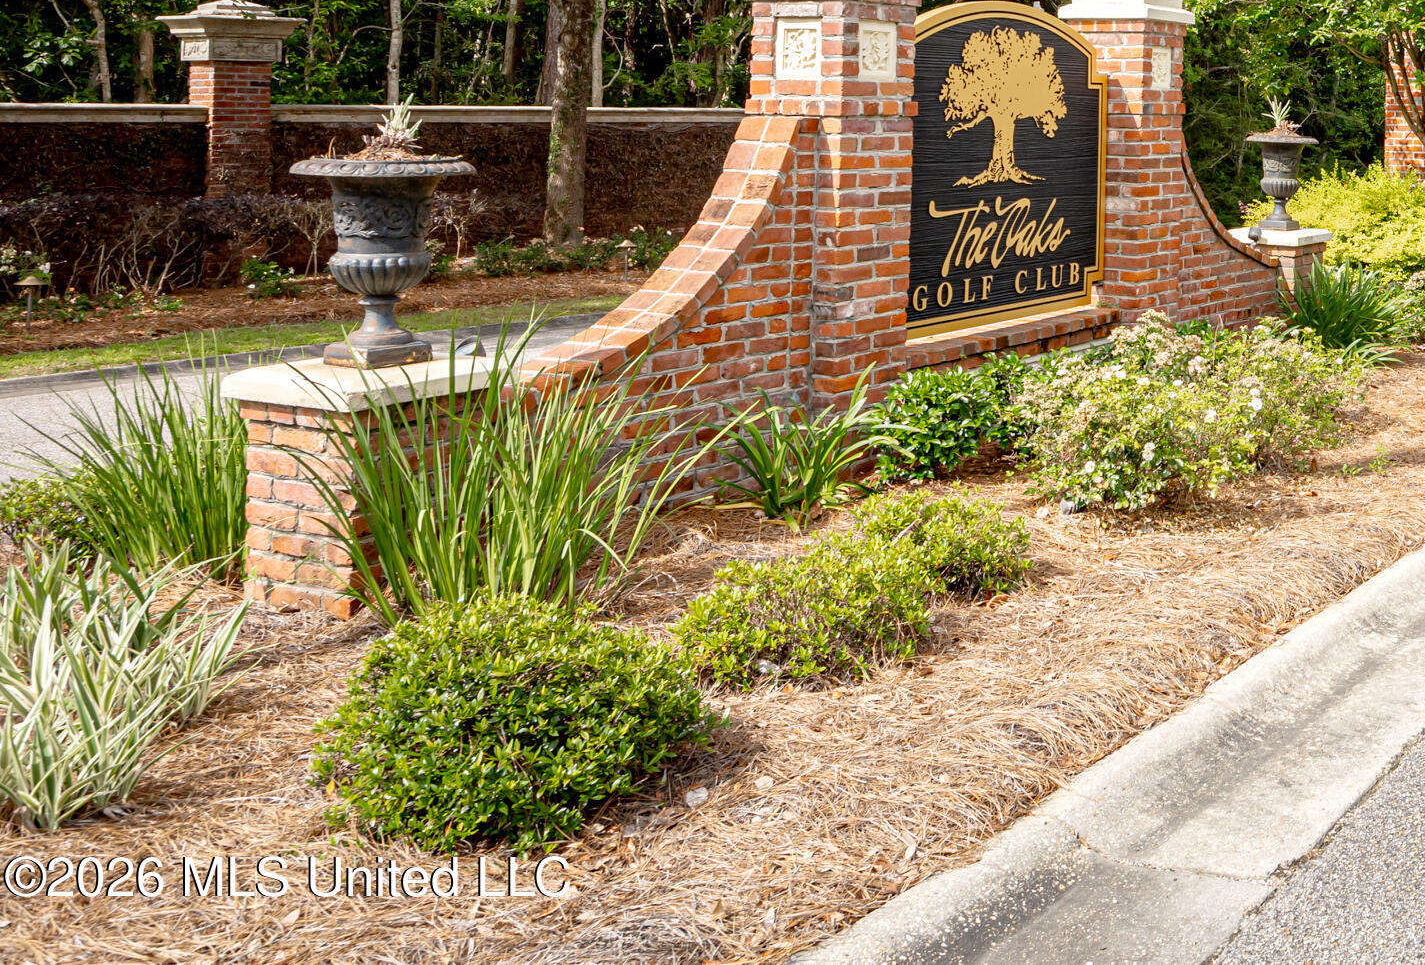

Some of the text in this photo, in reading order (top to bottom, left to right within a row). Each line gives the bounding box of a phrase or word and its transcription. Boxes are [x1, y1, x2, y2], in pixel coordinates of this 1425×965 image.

[928, 196, 1071, 277] The Oaks
[912, 262, 1080, 312] GOLF CLUB
